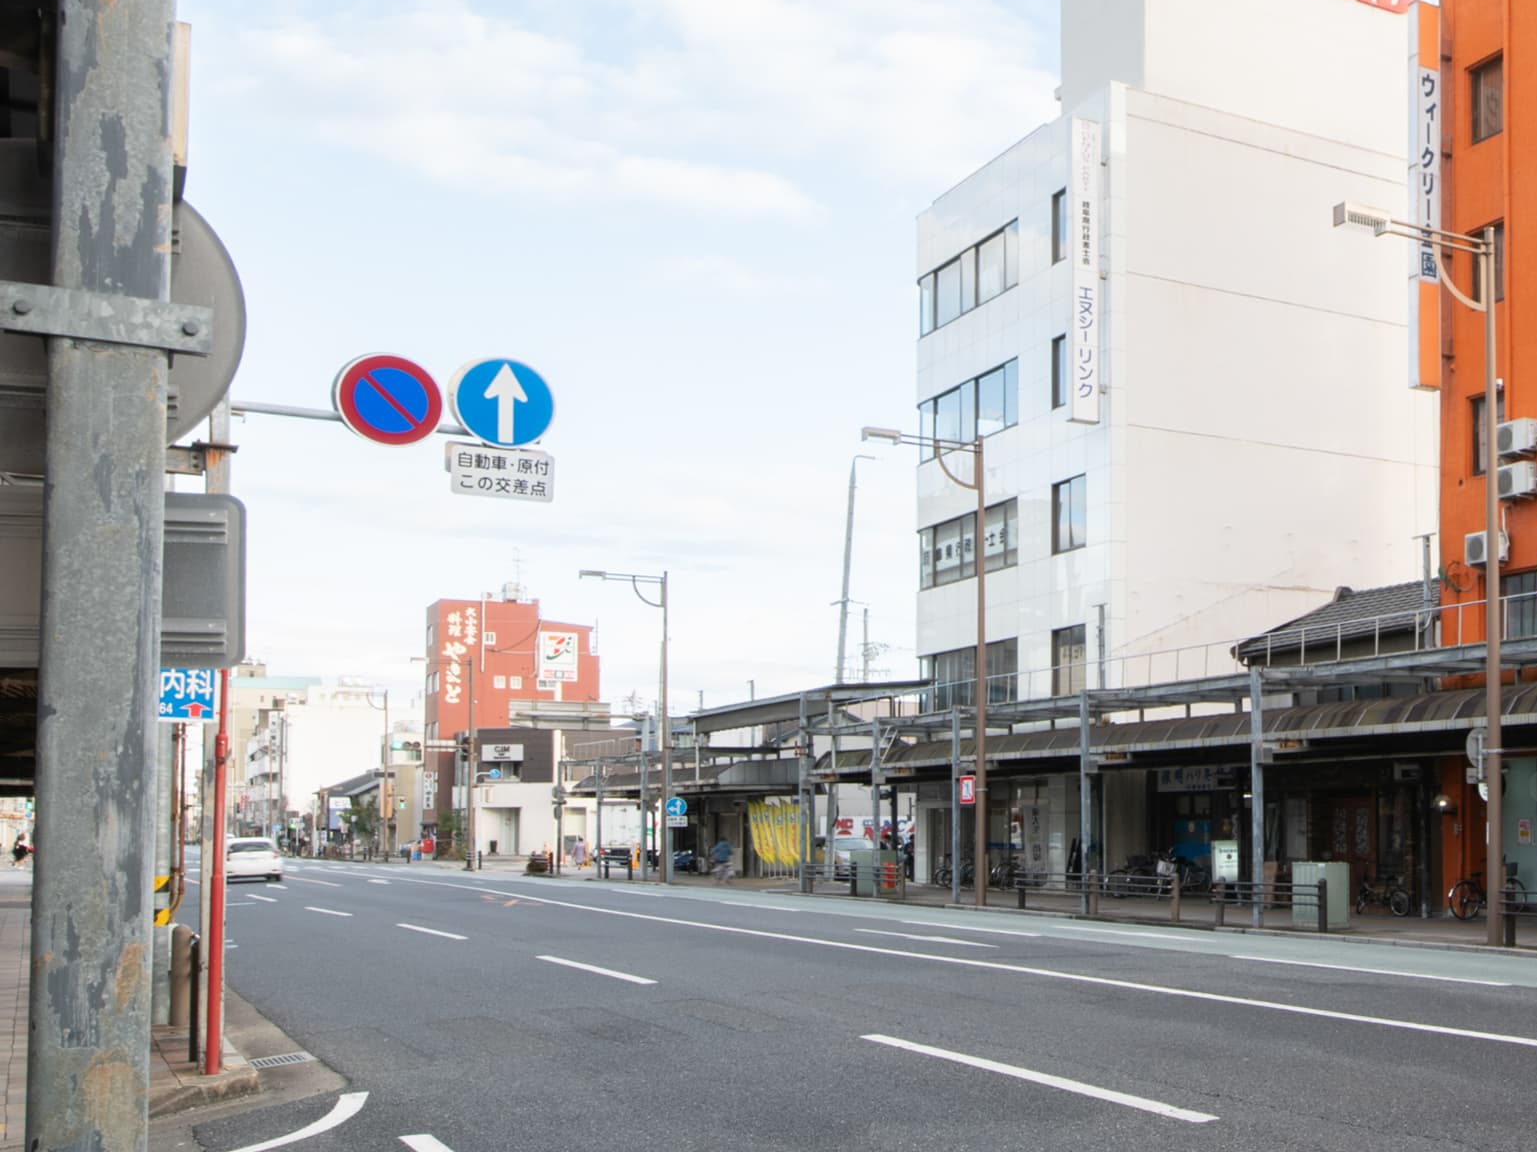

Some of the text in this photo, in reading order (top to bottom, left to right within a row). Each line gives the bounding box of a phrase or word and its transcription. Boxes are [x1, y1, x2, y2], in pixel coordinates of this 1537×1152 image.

[458, 452, 549, 476] 自動車・原付
[460, 474, 546, 497] この交差点
[160, 668, 213, 700] 内科
